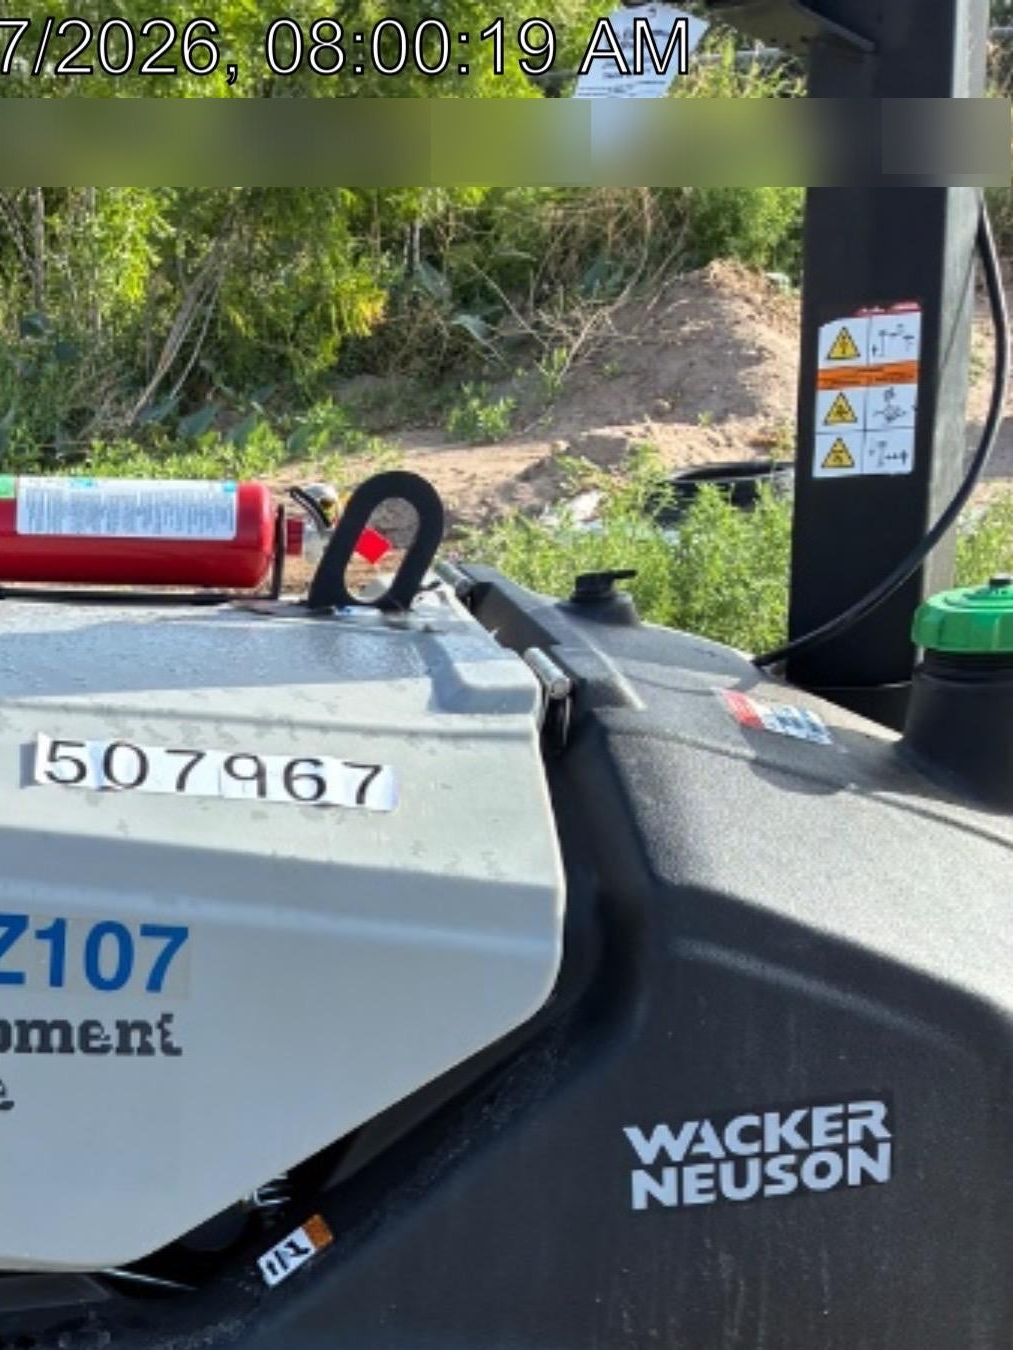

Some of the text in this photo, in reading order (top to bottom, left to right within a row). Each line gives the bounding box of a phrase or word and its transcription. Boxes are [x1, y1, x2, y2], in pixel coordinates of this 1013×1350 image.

[45, 738, 384, 806] 507967
[622, 1100, 892, 1165] WACKER
[631, 1142, 892, 1210] NEUSON
